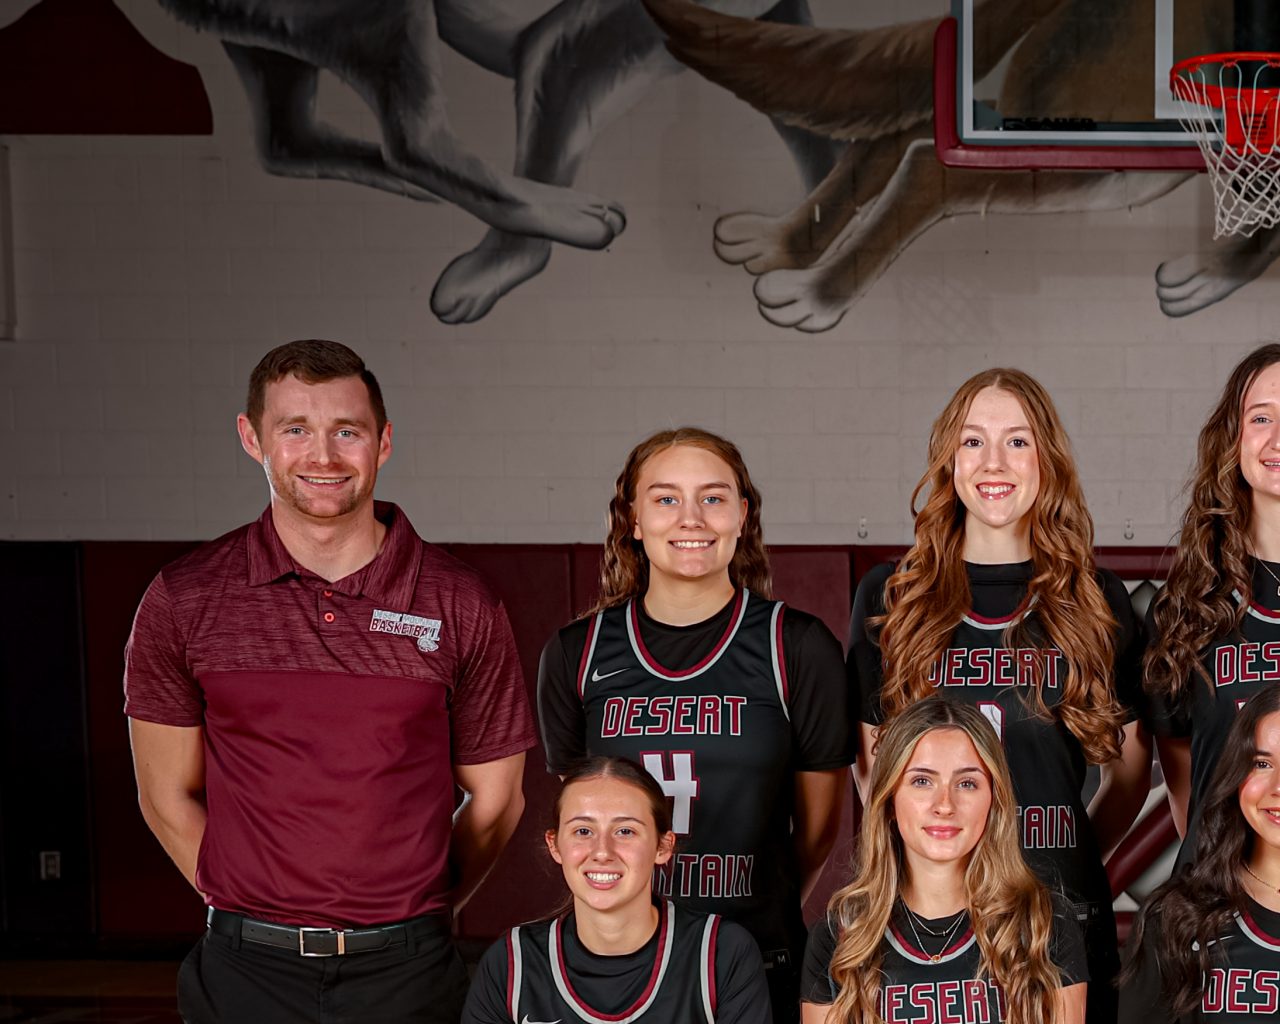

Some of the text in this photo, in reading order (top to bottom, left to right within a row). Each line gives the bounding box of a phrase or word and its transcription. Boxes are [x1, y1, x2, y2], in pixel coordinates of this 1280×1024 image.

[601, 695, 747, 738] DESERT
[640, 751, 700, 840] 4
[654, 854, 754, 898] NTAIN
